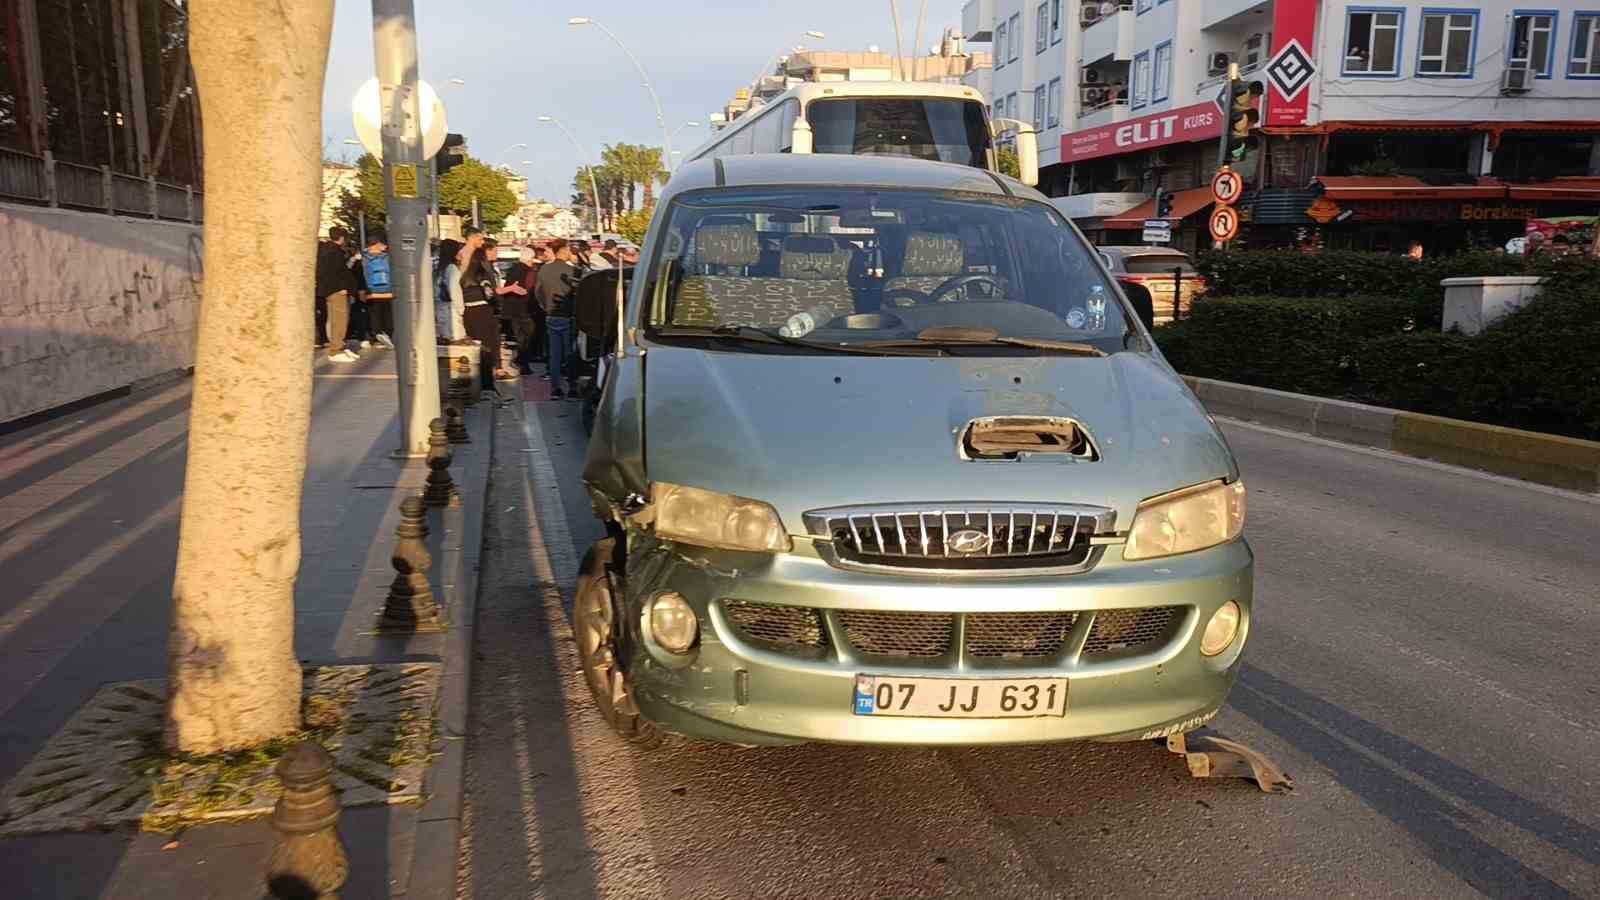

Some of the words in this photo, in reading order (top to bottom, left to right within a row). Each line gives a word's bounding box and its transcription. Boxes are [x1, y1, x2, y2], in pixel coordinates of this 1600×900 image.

[1183, 112, 1214, 130] KURS
[859, 698, 873, 707] TR
[876, 683, 916, 710] 07
[938, 686, 979, 712] JJ
[1000, 684, 1057, 711] 631
